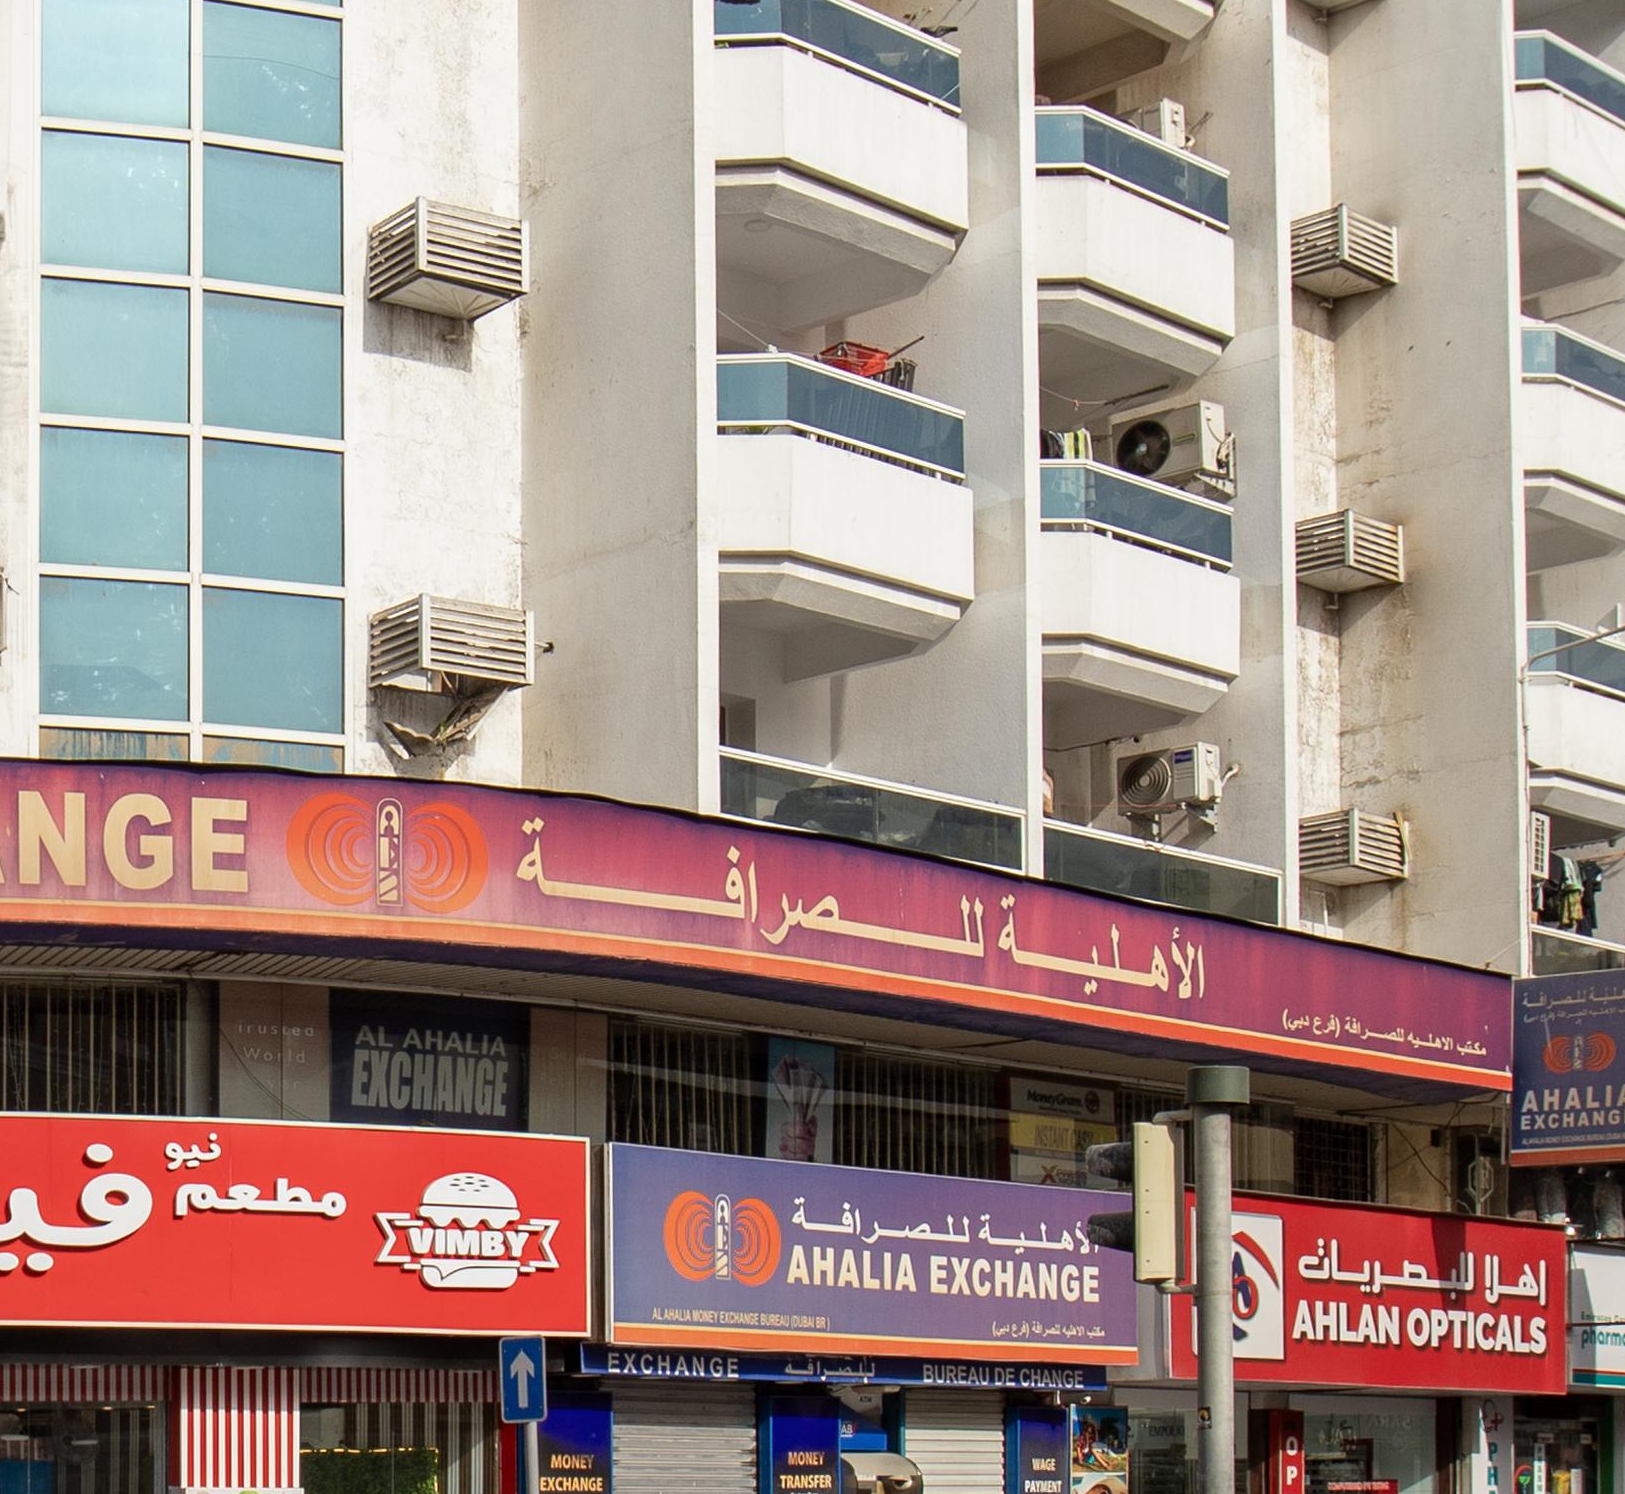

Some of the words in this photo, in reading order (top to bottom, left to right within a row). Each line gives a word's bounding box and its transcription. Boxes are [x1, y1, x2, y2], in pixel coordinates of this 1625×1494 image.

[515, 816, 984, 958] للصرافة
[998, 895, 1206, 999] الأهلية
[355, 1025, 394, 1048] AL
[402, 1028, 506, 1057] AHALIA
[1345, 1016, 1405, 1042] للصرافة
[1456, 1040, 1487, 1056] مكتب
[351, 1050, 508, 1118] EXCHANGE
[165, 1133, 223, 1170] نيو
[176, 1176, 349, 1219] مطعم
[791, 1196, 970, 1244] للصرافة
[409, 1227, 531, 1260] VIMBY
[787, 1244, 917, 1292] AHALIA
[929, 1255, 1100, 1302] EXCHANGE
[1297, 1237, 1473, 1299] للبصريات
[1484, 1254, 1547, 1307] اهلا
[652, 1308, 663, 1320] AL
[663, 1309, 691, 1322] AHALIA
[692, 1310, 719, 1324] MONEY
[719, 1311, 759, 1326] EXCHANGE
[760, 1313, 790, 1327] BUREAU
[790, 1315, 816, 1330] (DUBAI
[1293, 1300, 1400, 1348] AHLAN
[1406, 1308, 1547, 1356] OPTICALS
[607, 1352, 739, 1378] EXCHANGE
[923, 1364, 990, 1385] BUREAU
[993, 1367, 1016, 1386] DE
[1019, 1368, 1083, 1388] CHANGE
[550, 1454, 595, 1471] MONEY
[788, 1451, 824, 1466] MONEY
[1032, 1458, 1056, 1471] WAGE
[540, 1476, 603, 1492] EXCHANGE
[780, 1475, 832, 1489] TRANSFER
[1024, 1480, 1062, 1493] PAYMENT
